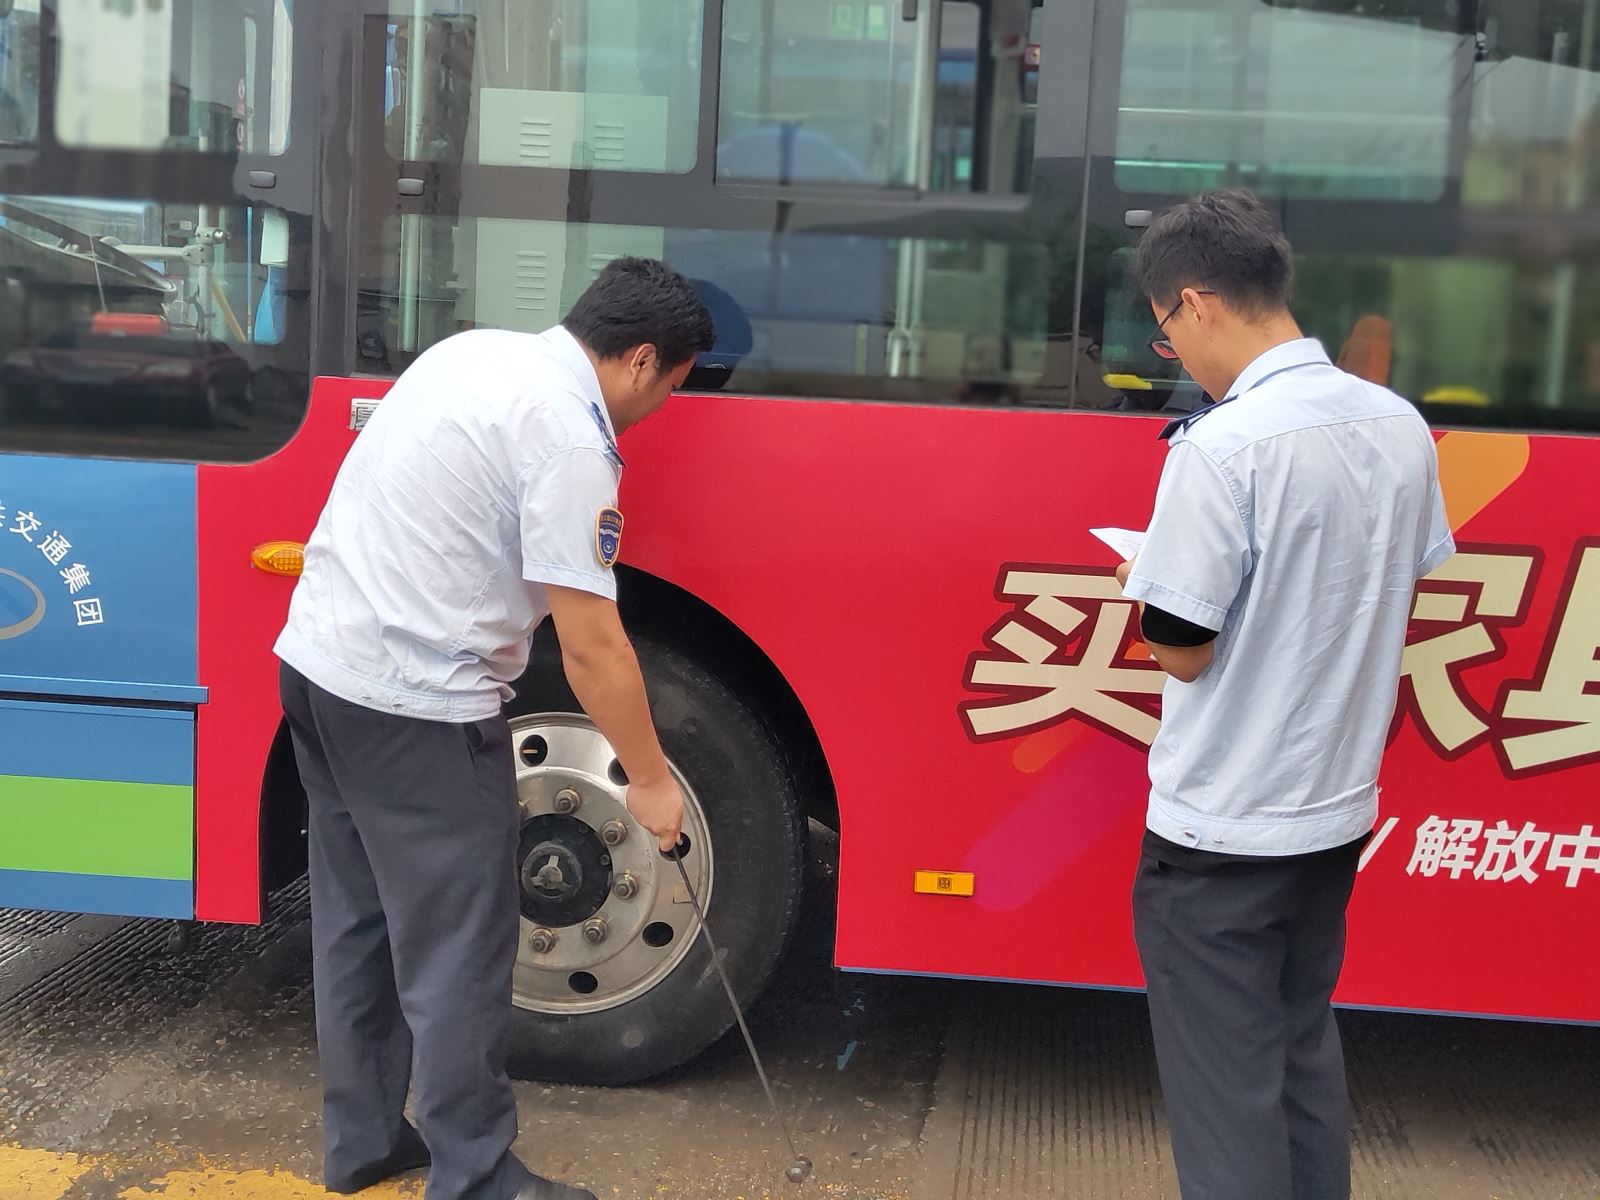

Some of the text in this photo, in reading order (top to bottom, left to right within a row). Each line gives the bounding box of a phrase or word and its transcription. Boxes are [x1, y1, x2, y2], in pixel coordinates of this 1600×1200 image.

[0, 502, 104, 626] 交通集团
[1406, 815, 1600, 888] 解放中
